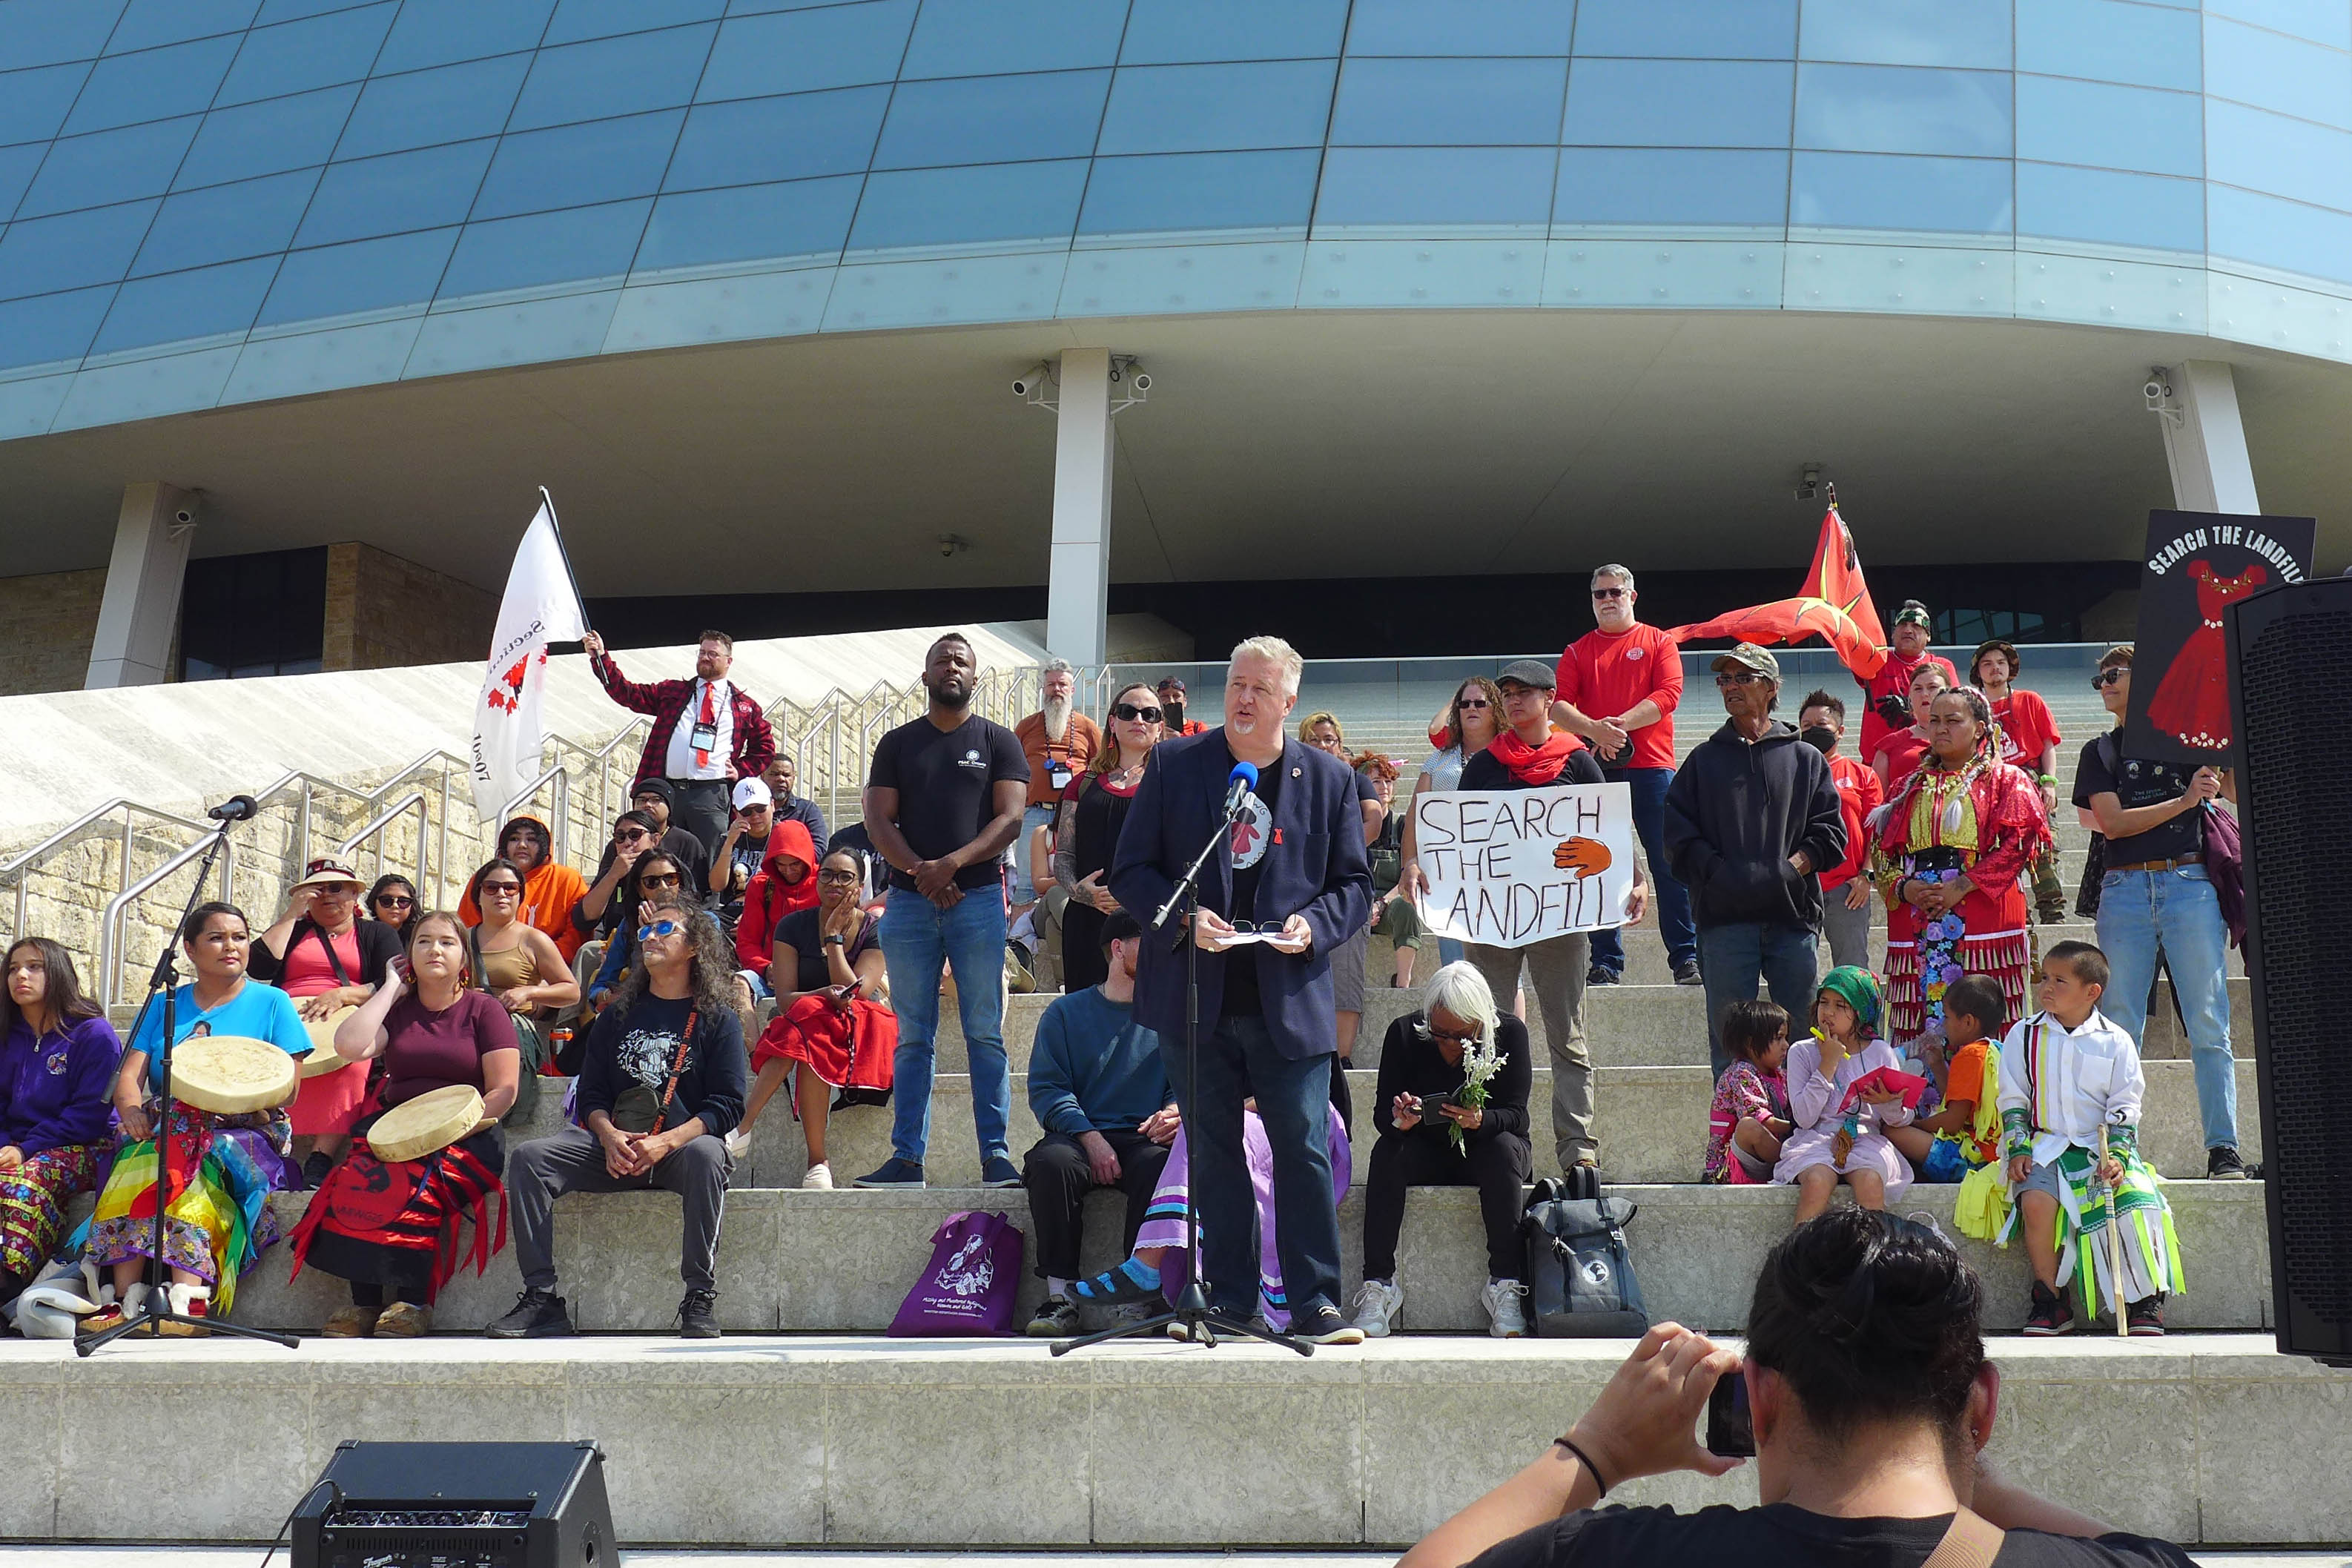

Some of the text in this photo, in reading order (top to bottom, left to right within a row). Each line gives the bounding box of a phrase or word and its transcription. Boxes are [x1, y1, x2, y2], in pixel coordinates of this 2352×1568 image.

[2148, 528, 2208, 575] SEARCH
[2213, 526, 2242, 545] THE
[1420, 795, 1600, 847] SEARCH
[1423, 843, 1512, 881] THE
[1418, 876, 1620, 941] LANDFILL
[683, 1012, 697, 1039] BENCH
[673, 1043, 688, 1072] BENCH
[663, 1077, 678, 1105] BENCH
